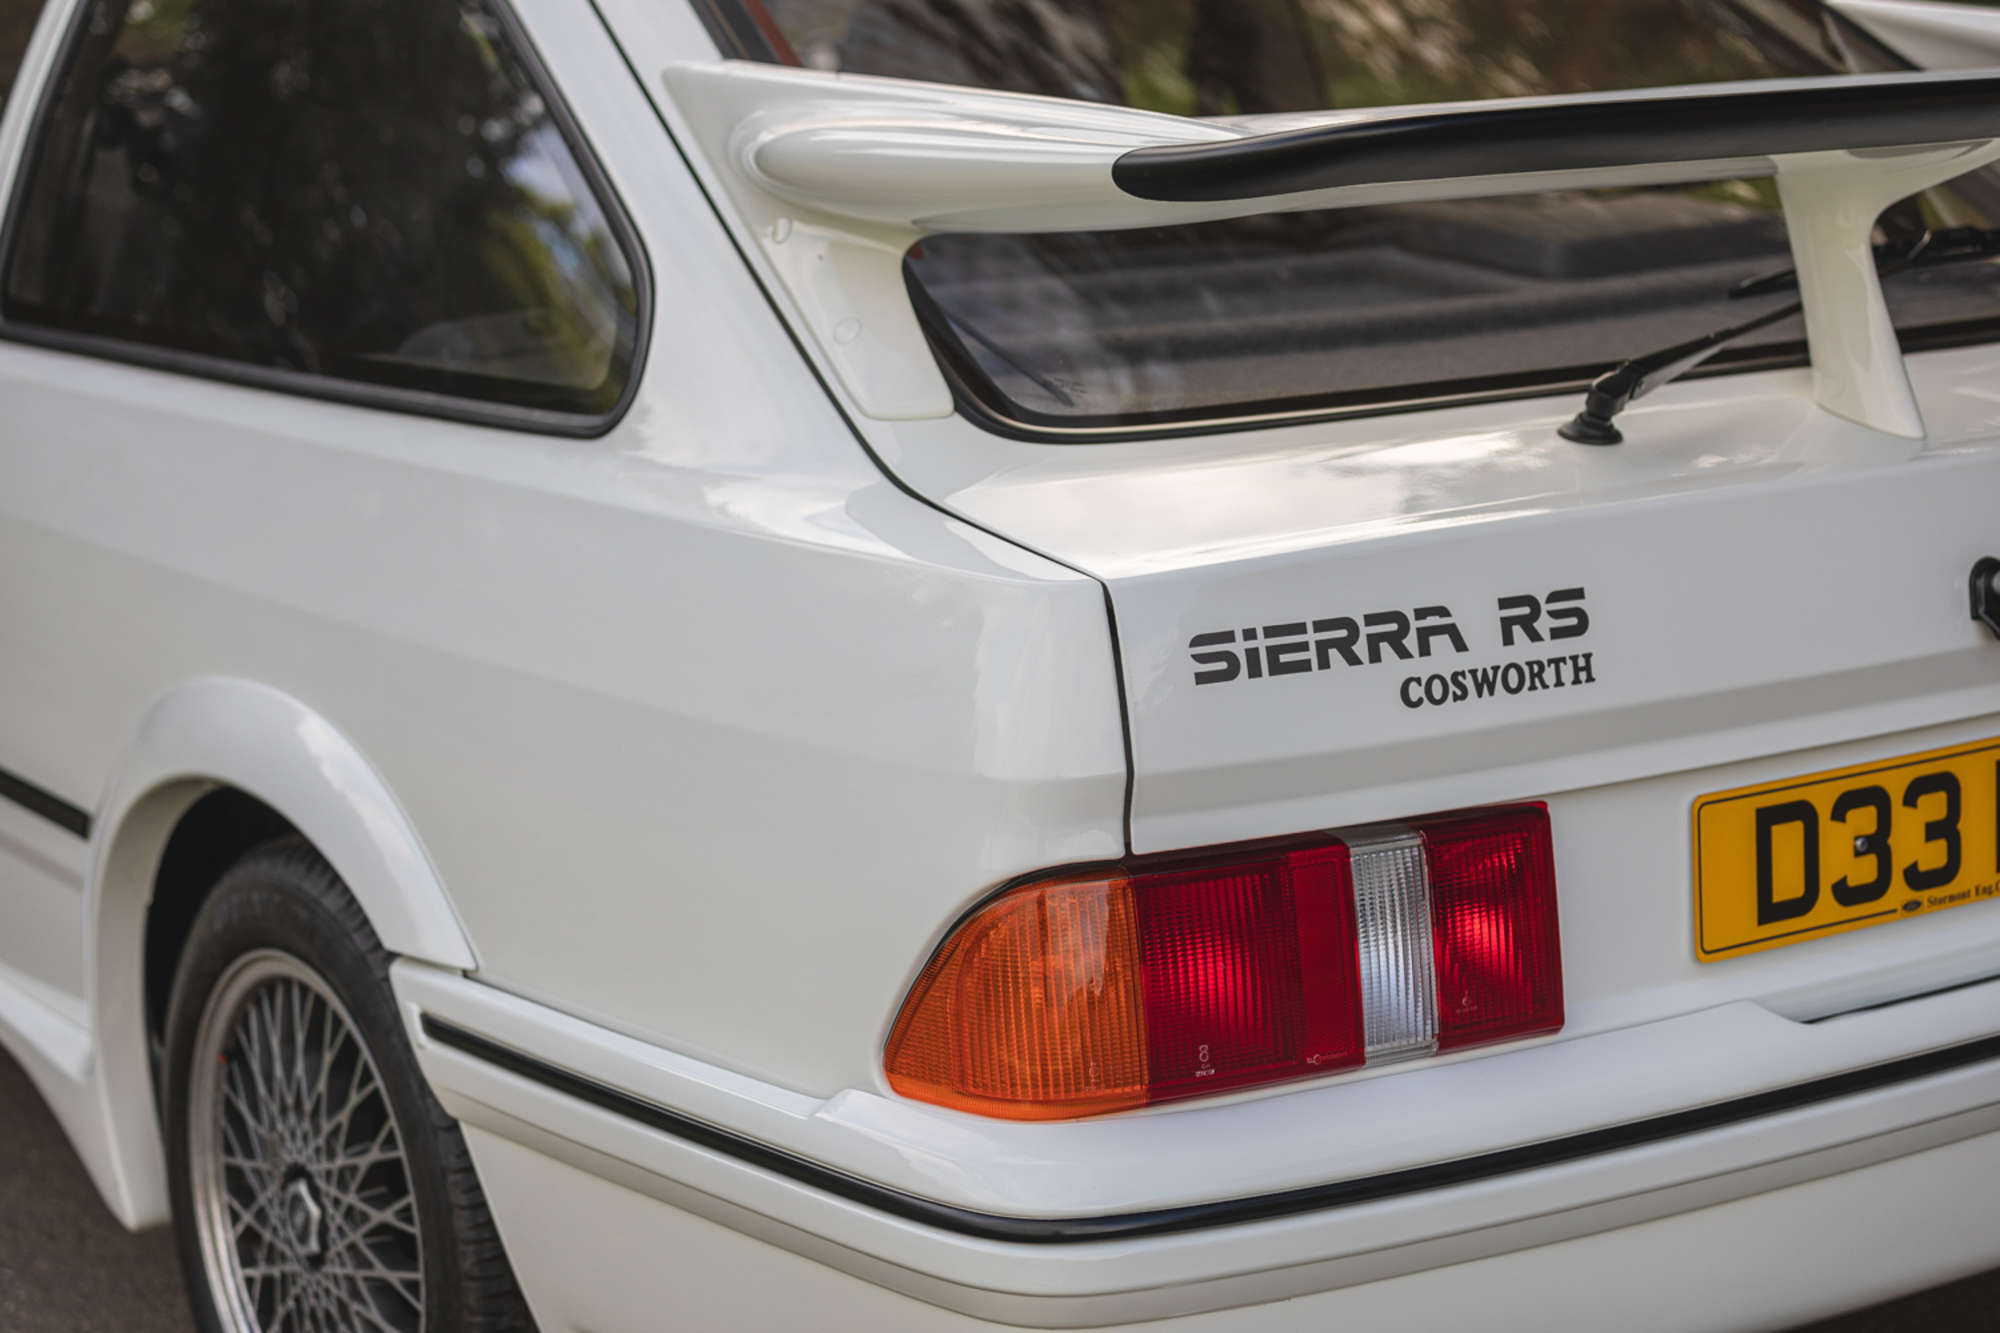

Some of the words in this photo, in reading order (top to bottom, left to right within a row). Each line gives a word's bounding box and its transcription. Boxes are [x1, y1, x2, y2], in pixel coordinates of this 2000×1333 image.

[1189, 606, 1469, 685] SIERRA
[1498, 587, 1589, 646] RS
[1400, 653, 1595, 708] COSWORTH
[1755, 769, 1962, 927] D33
